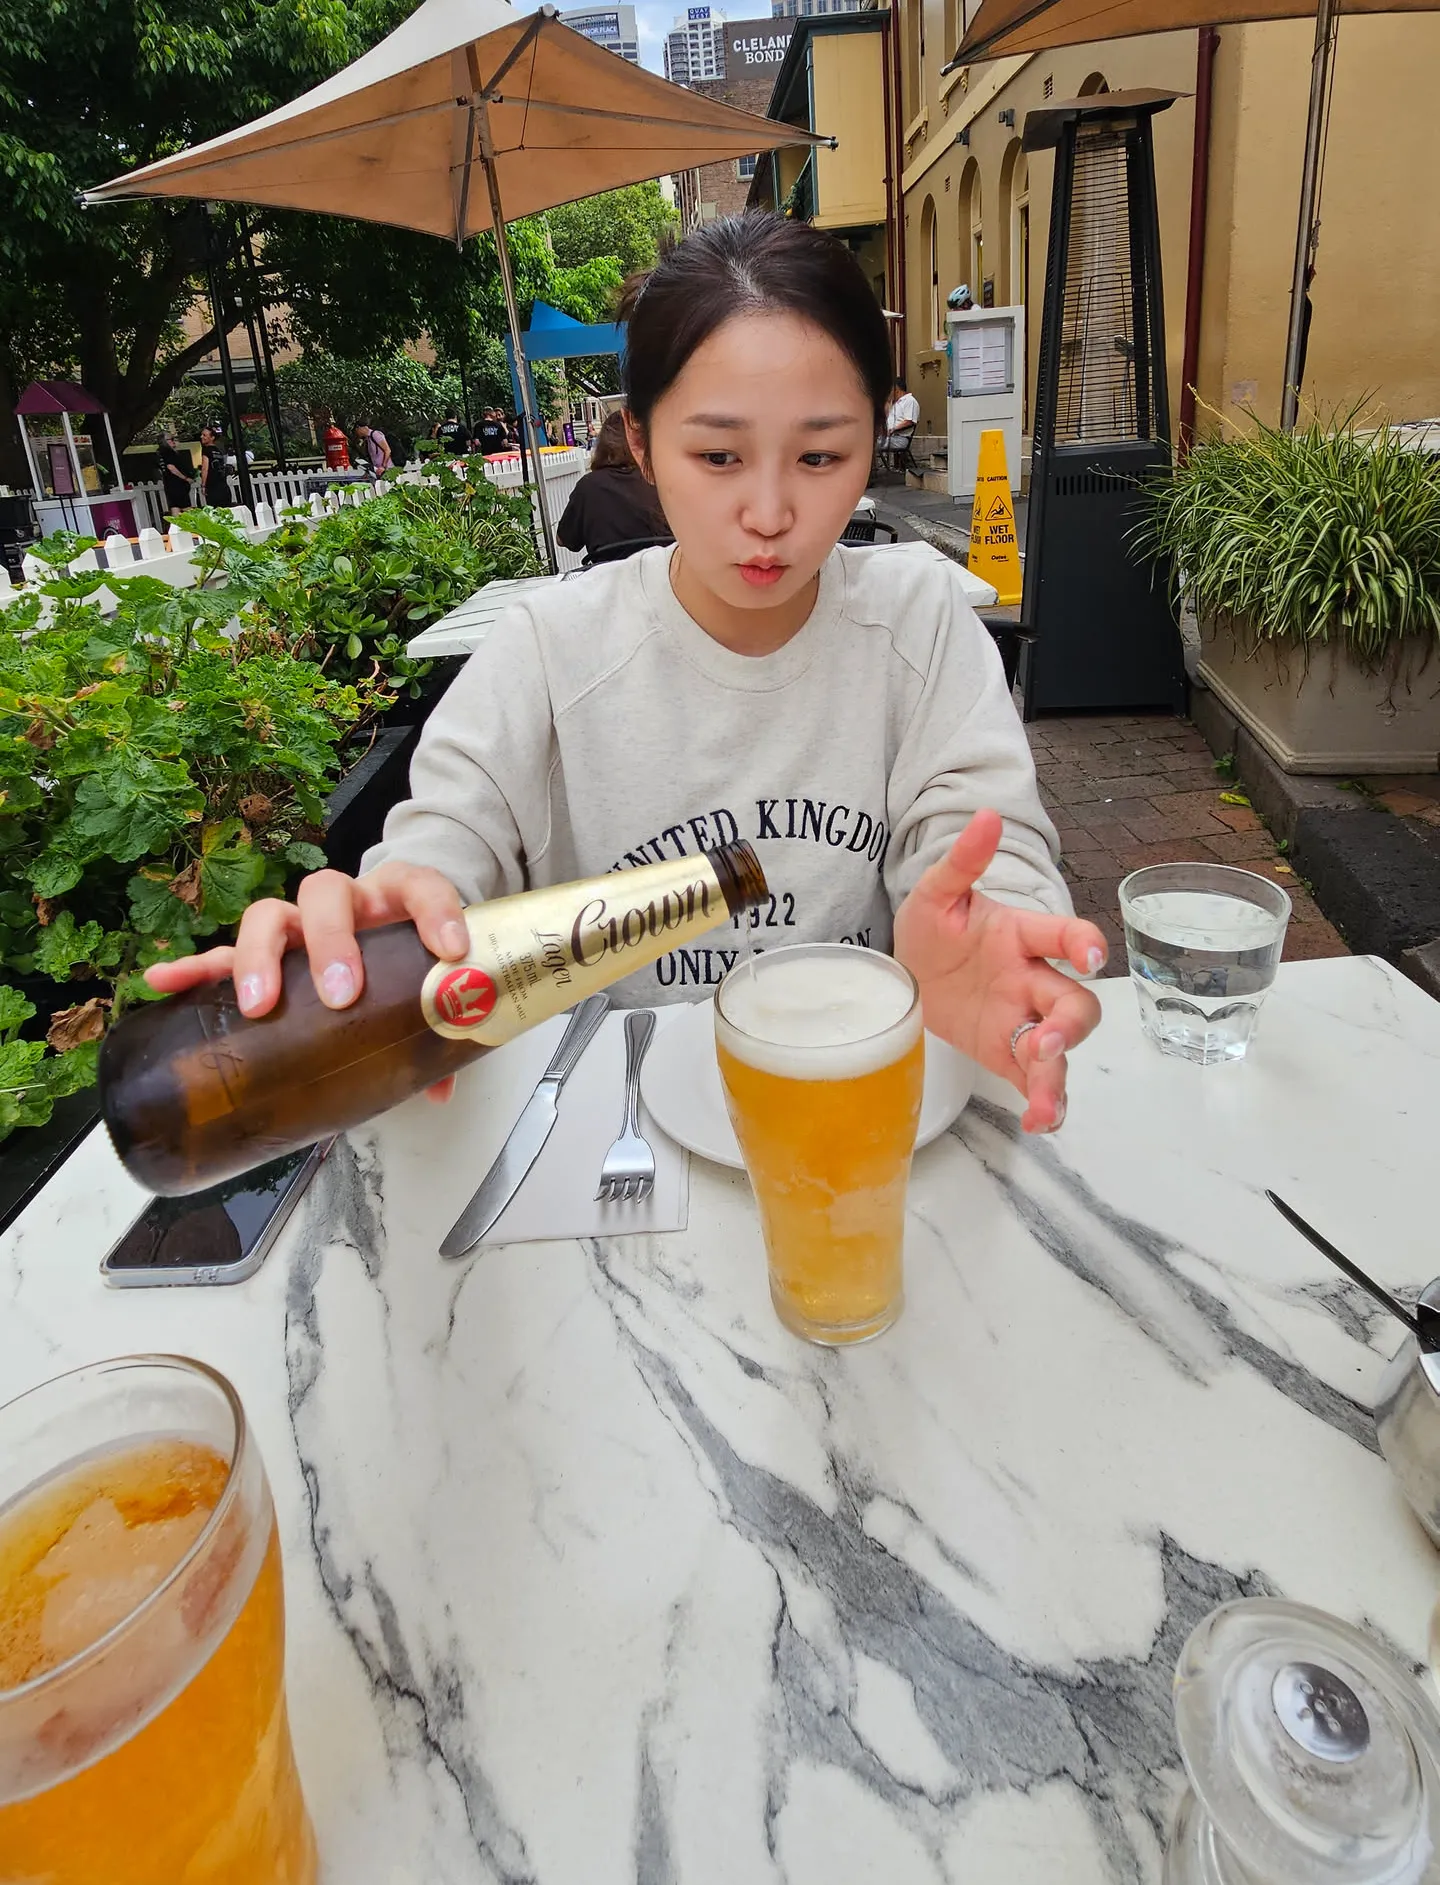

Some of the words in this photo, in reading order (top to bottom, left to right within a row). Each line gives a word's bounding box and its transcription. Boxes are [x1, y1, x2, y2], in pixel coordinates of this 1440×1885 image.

[745, 49, 785, 64] BOND
[985, 534, 1014, 545] FLOOR
[989, 525, 1009, 534] WET
[755, 798, 889, 873] KINGDO
[571, 879, 711, 967] Crown
[504, 950, 518, 975] MADE
[515, 977, 529, 1001] FROM
[530, 928, 572, 988] Lager
[656, 949, 738, 986] ONLY
[496, 953, 519, 1003] AUSTRALIAN
[516, 1004, 527, 1021] MALT
